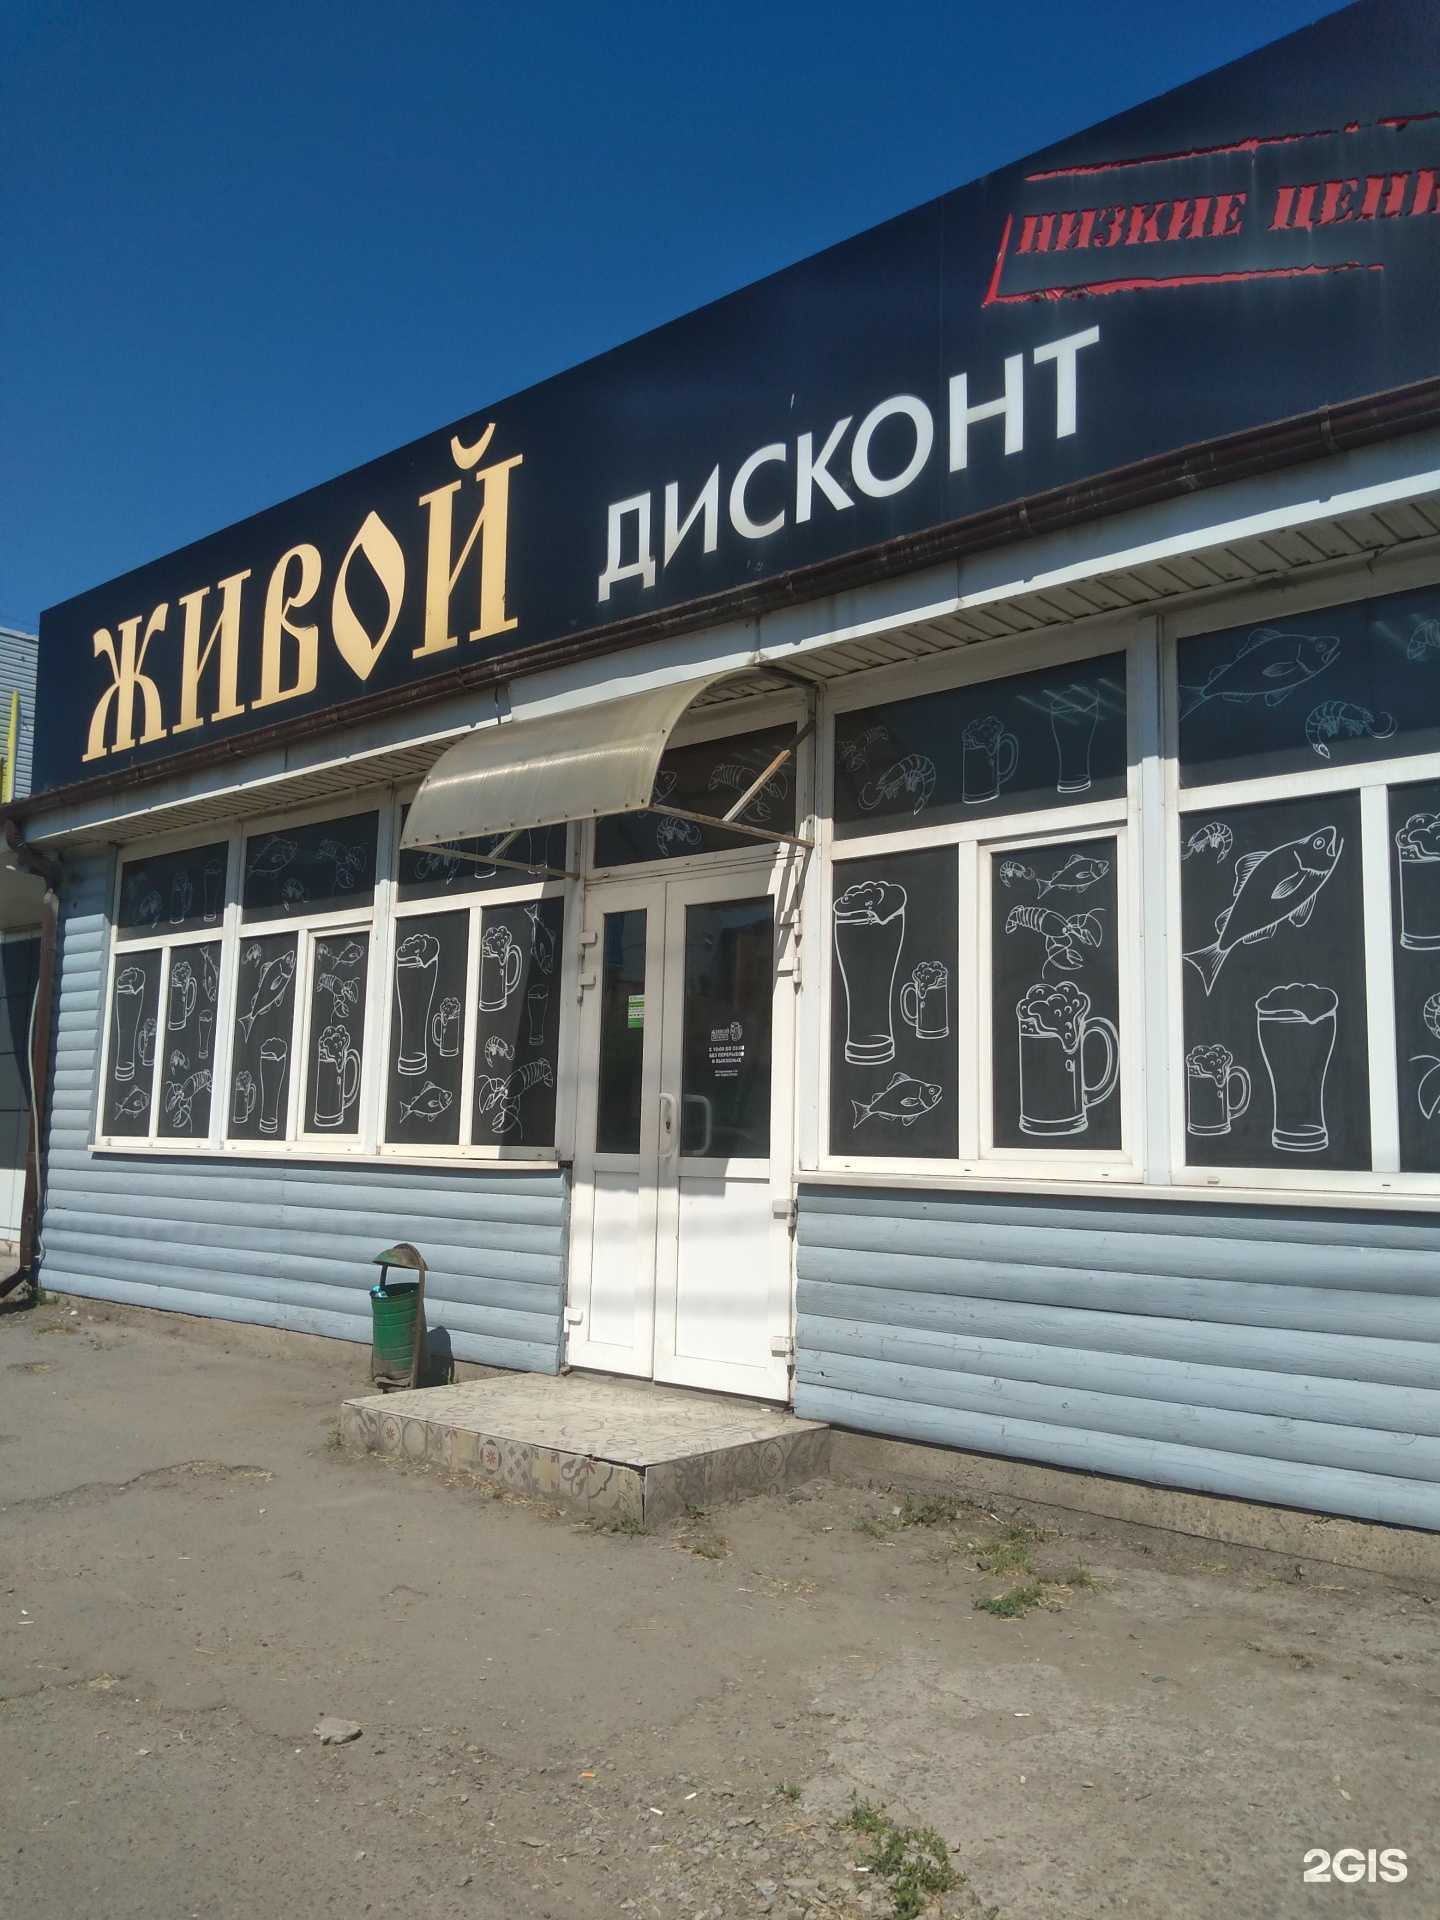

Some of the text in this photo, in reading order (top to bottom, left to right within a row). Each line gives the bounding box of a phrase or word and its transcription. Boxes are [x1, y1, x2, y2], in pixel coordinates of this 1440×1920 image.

[1016, 192, 1247, 254] НИЗКИЕ
[82, 423, 523, 762] ЖИВОЙ
[598, 325, 1100, 602] ДИСКОНТ
